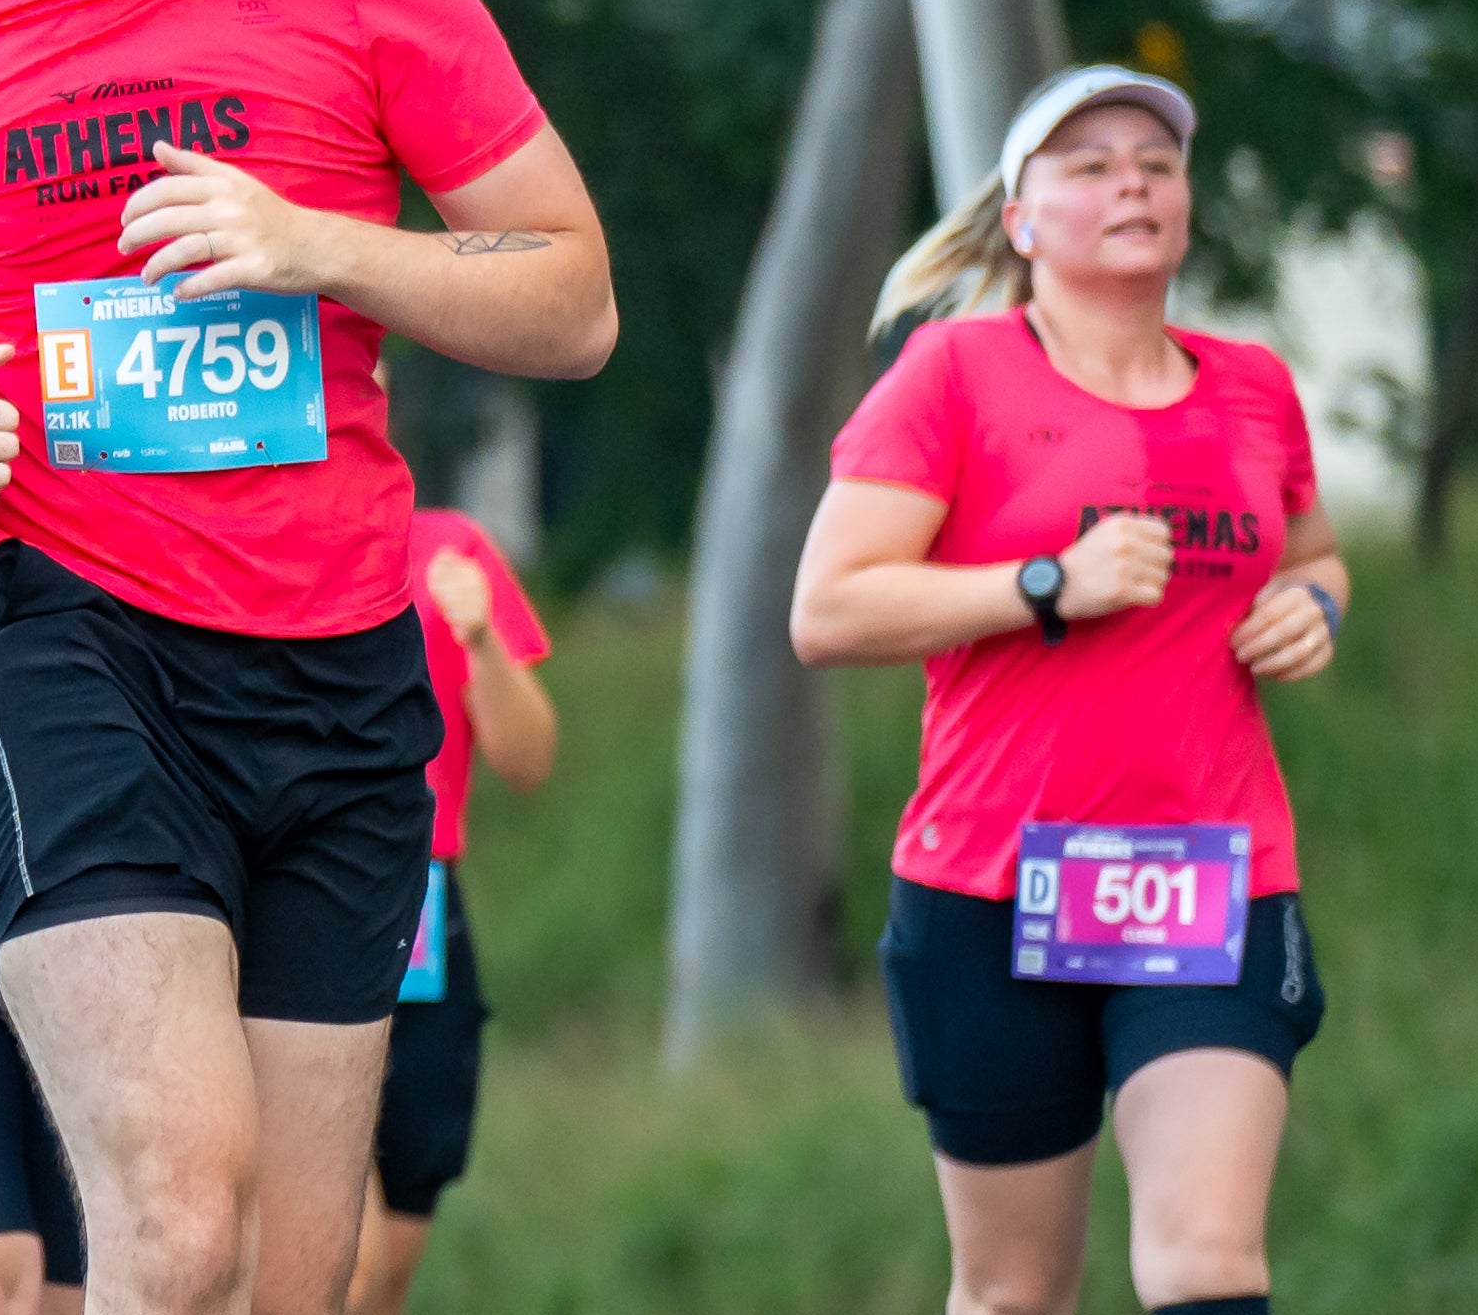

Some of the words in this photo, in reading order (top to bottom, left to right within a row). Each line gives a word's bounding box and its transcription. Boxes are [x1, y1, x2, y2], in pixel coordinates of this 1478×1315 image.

[3, 95, 250, 184] ATHENAS
[36, 178, 100, 206] RUN
[109, 170, 167, 196] FAS
[92, 294, 176, 321] ATHENAS
[55, 341, 78, 392] E
[115, 318, 290, 399] 4759
[46, 409, 92, 430] 21.1K
[167, 400, 239, 422] ROBERTO
[1029, 867, 1049, 904] D
[1092, 863, 1198, 926] 501
